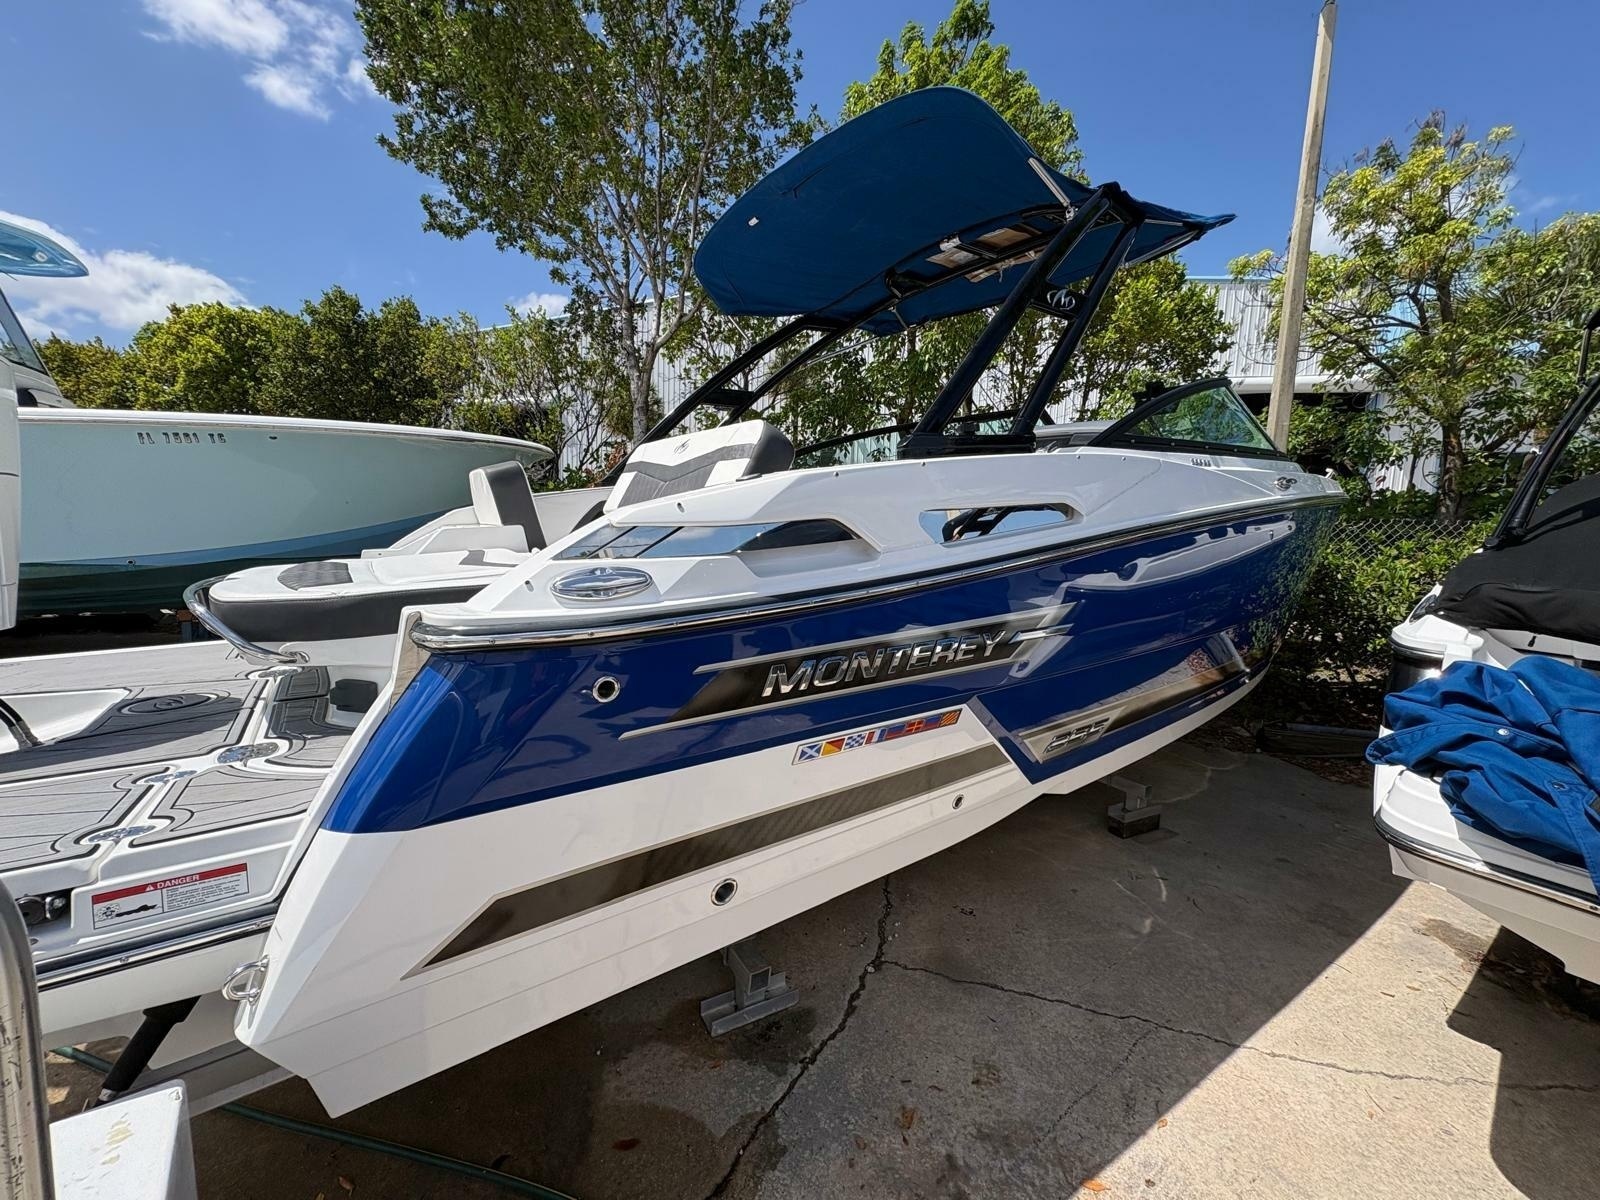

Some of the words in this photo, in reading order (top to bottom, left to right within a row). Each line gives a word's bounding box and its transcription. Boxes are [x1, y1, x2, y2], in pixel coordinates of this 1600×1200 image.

[137, 432, 155, 444] FL
[761, 630, 1006, 697] MONTEREY
[156, 874, 200, 889] DANGER
